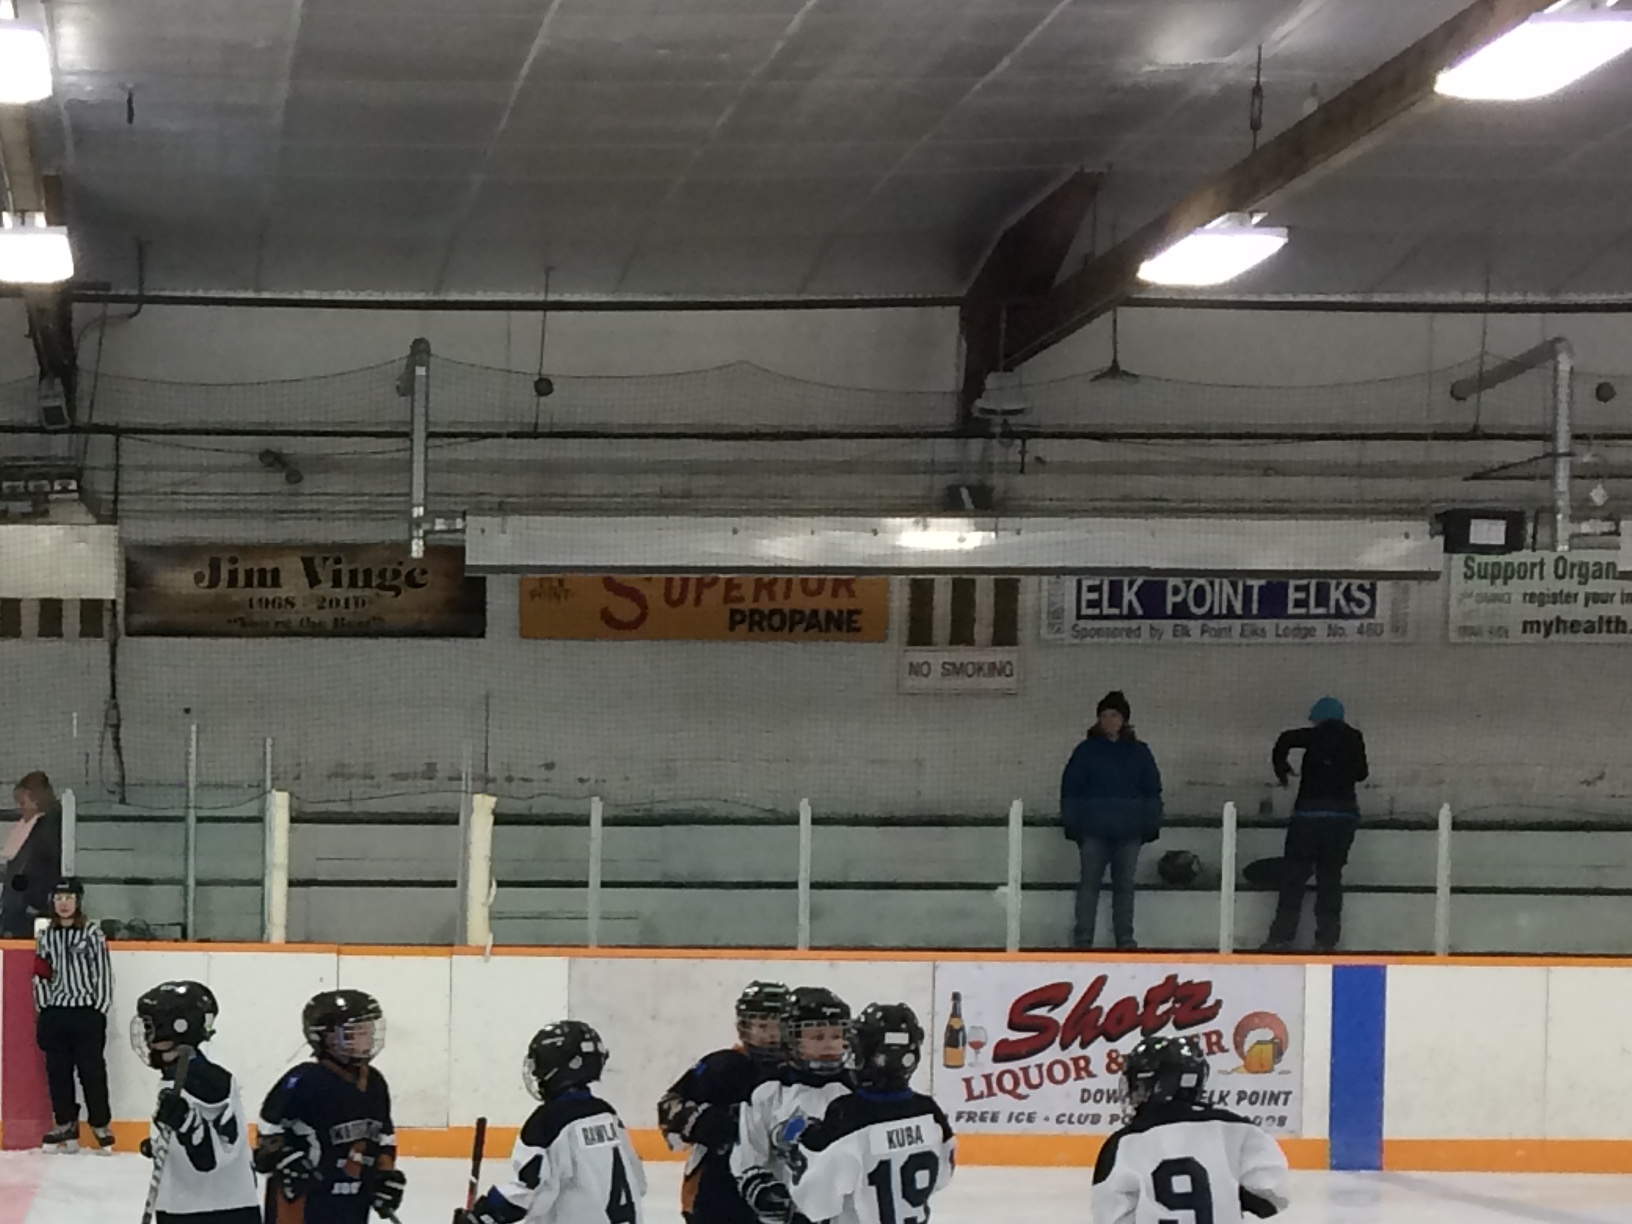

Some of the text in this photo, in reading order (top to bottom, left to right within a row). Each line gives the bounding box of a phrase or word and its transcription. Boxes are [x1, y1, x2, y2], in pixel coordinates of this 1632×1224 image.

[194, 556, 429, 598] Jim Vinge
[1463, 556, 1618, 585] Support Organ
[1080, 578, 1144, 616] ELK
[1166, 578, 1266, 616] POINT
[1287, 579, 1372, 616] ELKS
[1522, 589, 1579, 607] register
[1583, 591, 1616, 608] your
[729, 608, 862, 633] PROPANE
[1071, 624, 1141, 640] Sponsored
[1149, 624, 1165, 640] by
[1172, 624, 1191, 637] Elk
[1200, 624, 1233, 637] Point
[1239, 624, 1267, 638] Elks
[1274, 624, 1317, 640] Lodge
[1326, 625, 1348, 638] No.
[908, 661, 1014, 678] NO SMOKING
[992, 974, 1223, 1063] Shotz
[962, 1055, 1098, 1103] LIQUOR
[1236, 1090, 1293, 1107] POINT
[954, 1110, 1002, 1125] FREE
[1006, 1111, 1037, 1125] ICE
[1055, 1111, 1102, 1126] CLUB
[886, 1124, 924, 1150] KUBA
